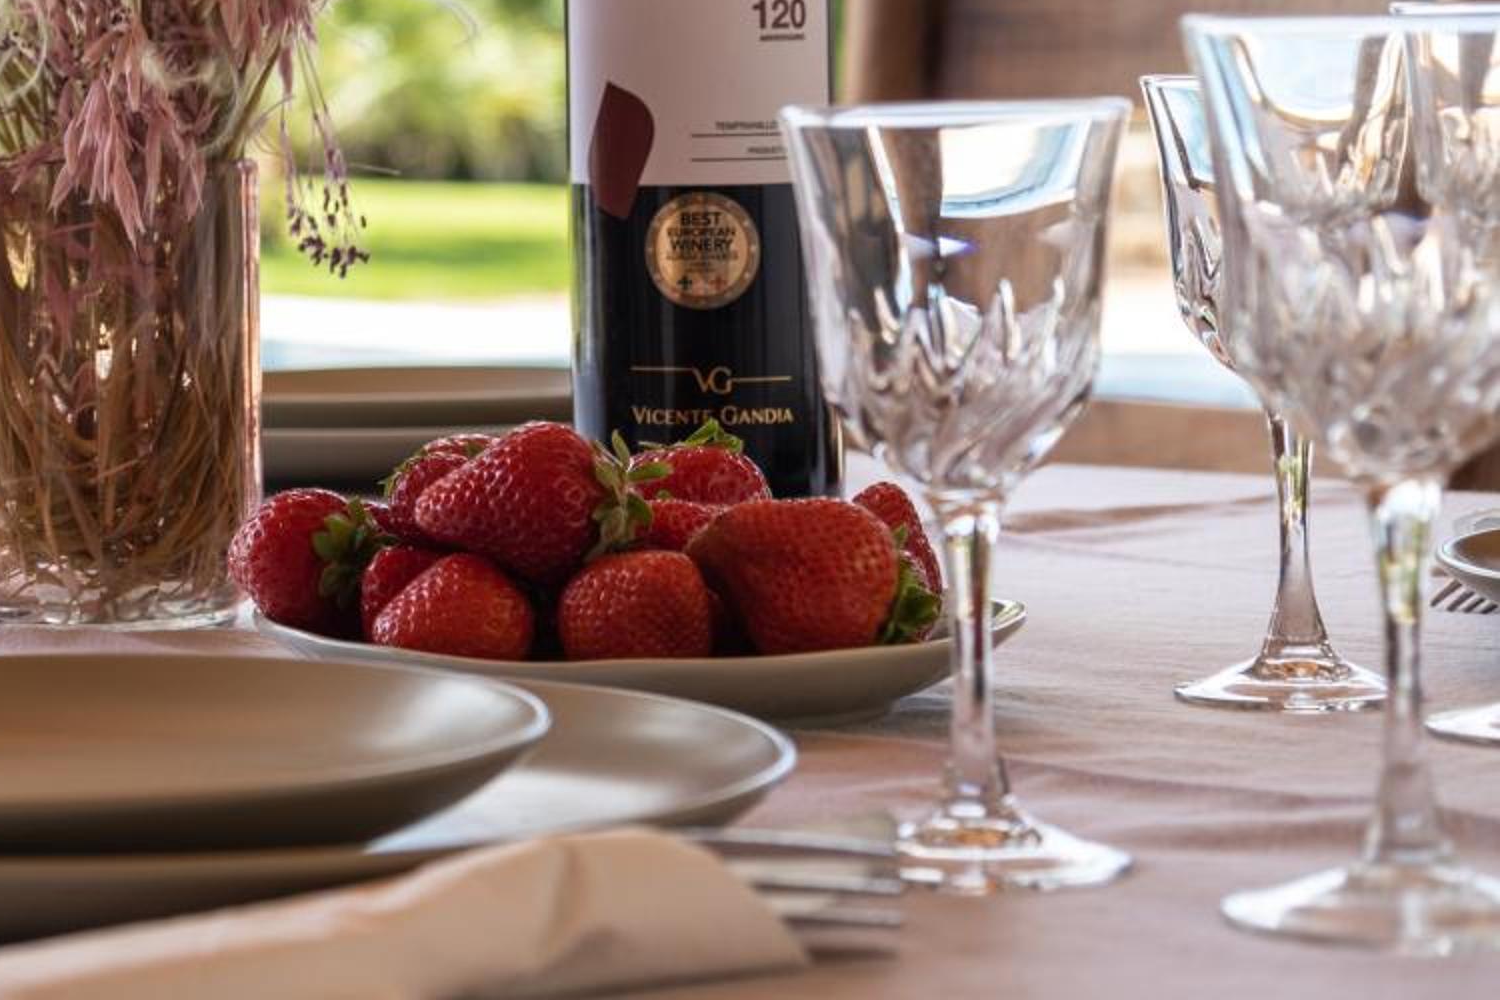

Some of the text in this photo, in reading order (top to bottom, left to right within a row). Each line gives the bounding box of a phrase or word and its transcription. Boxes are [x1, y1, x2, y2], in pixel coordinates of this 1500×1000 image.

[681, 211, 722, 226] BEST
[666, 226, 737, 238] EUROPEAN
[668, 238, 734, 251] WINERY
[692, 366, 733, 395] VG
[721, 405, 795, 426] GANDIA
